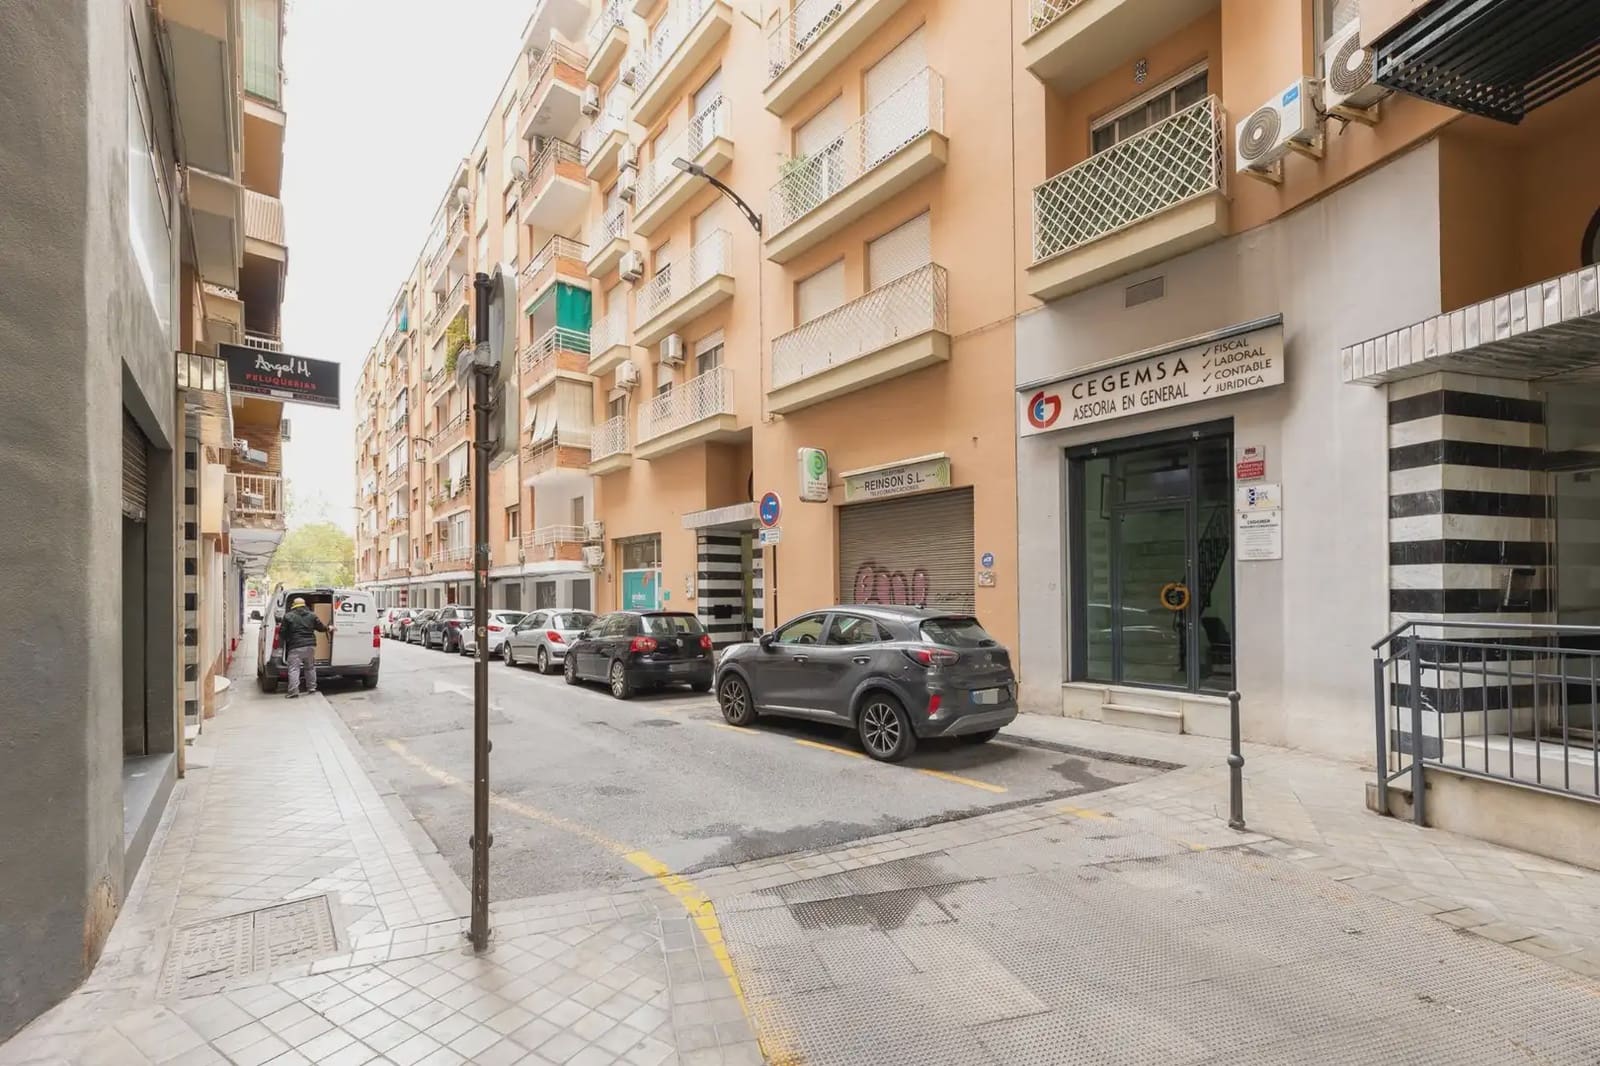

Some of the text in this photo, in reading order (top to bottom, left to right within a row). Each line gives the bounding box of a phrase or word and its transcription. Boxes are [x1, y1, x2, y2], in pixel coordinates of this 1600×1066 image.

[1214, 338, 1249, 354] FISCAL
[255, 354, 294, 378] Angel
[1214, 347, 1266, 367] LABORAL
[1071, 358, 1190, 400] CEGEMSA
[1214, 358, 1273, 380] CONTABLE
[245, 373, 317, 389] PELUQUERIAS
[1215, 375, 1264, 393] JURIDICA
[1073, 383, 1189, 421] ASESORIA EN GENERAL
[864, 472, 925, 491] REINSON S.L.
